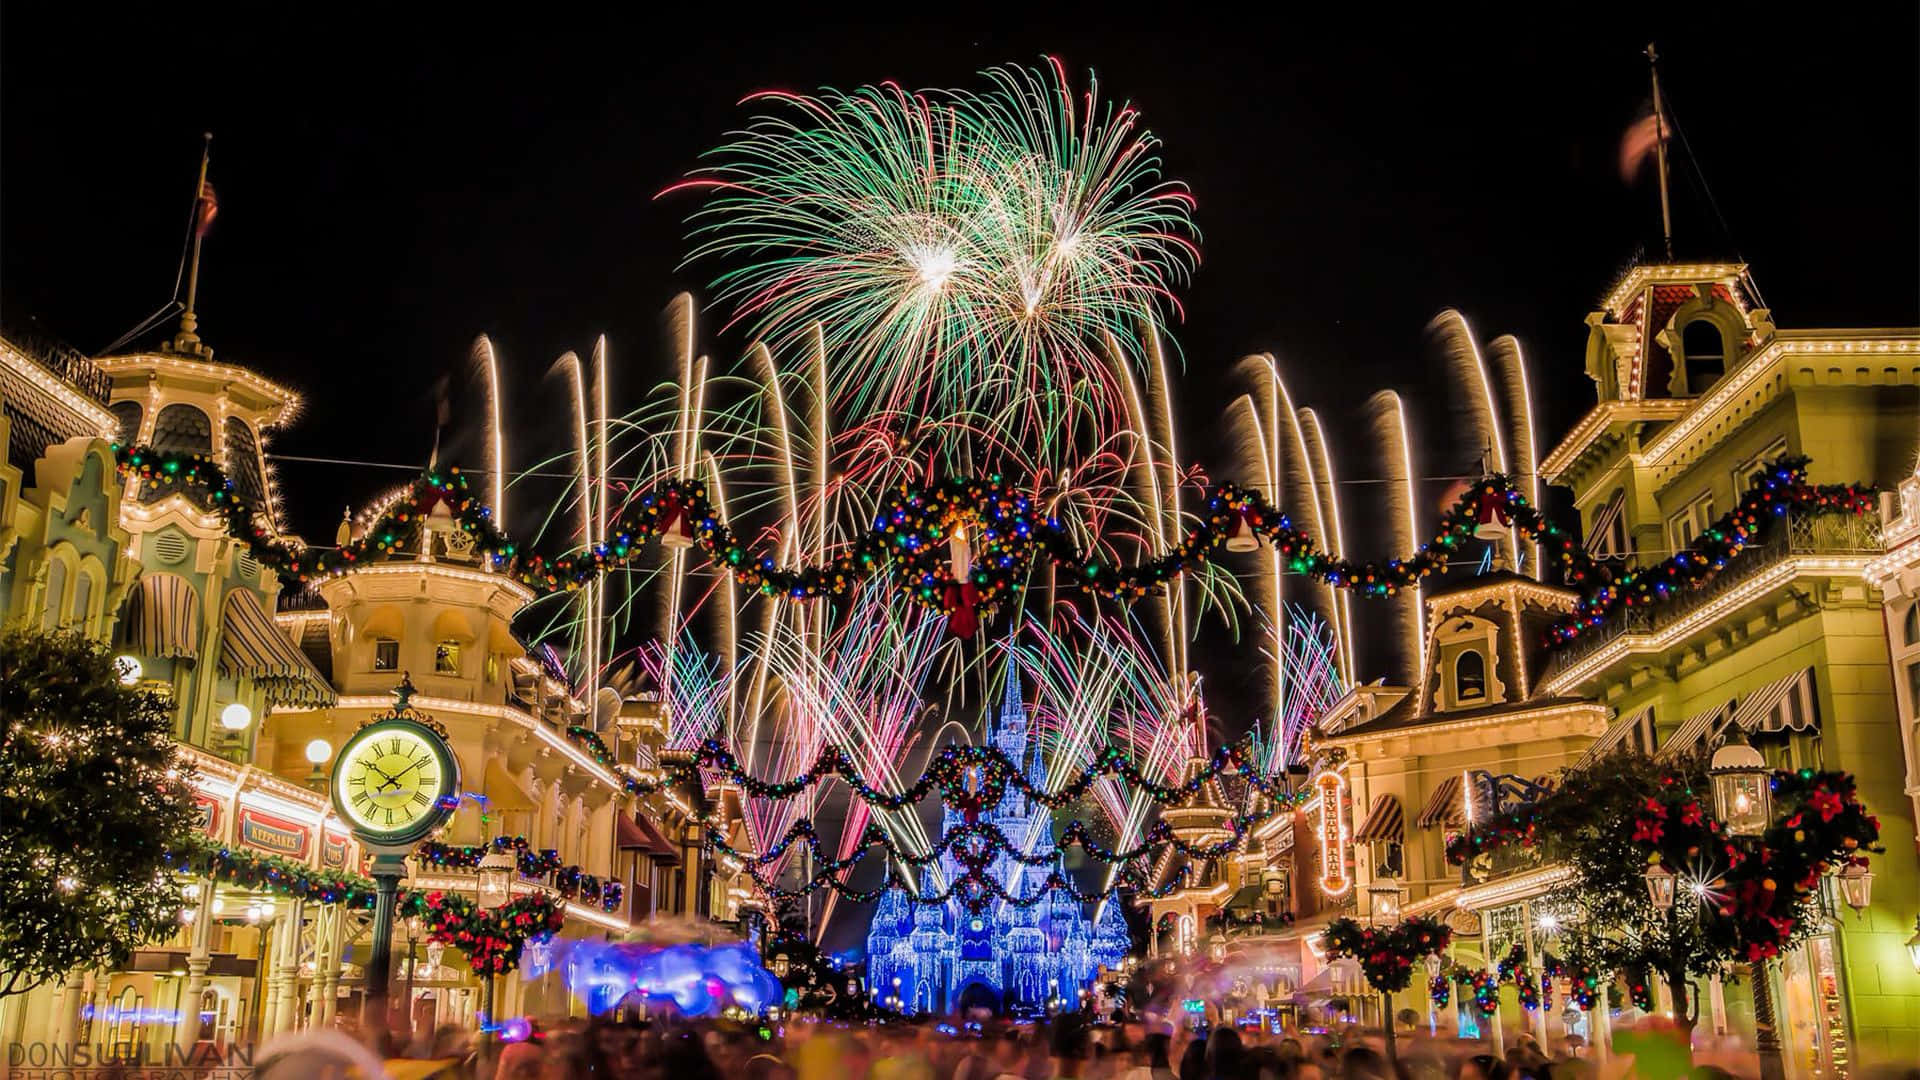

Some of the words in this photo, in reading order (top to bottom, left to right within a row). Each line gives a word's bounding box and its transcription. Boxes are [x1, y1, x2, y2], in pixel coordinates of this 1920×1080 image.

[1326, 789, 1338, 841] CRYSTAL
[252, 826, 296, 849] KEEPSAKES
[1328, 847, 1339, 877] ARTS
